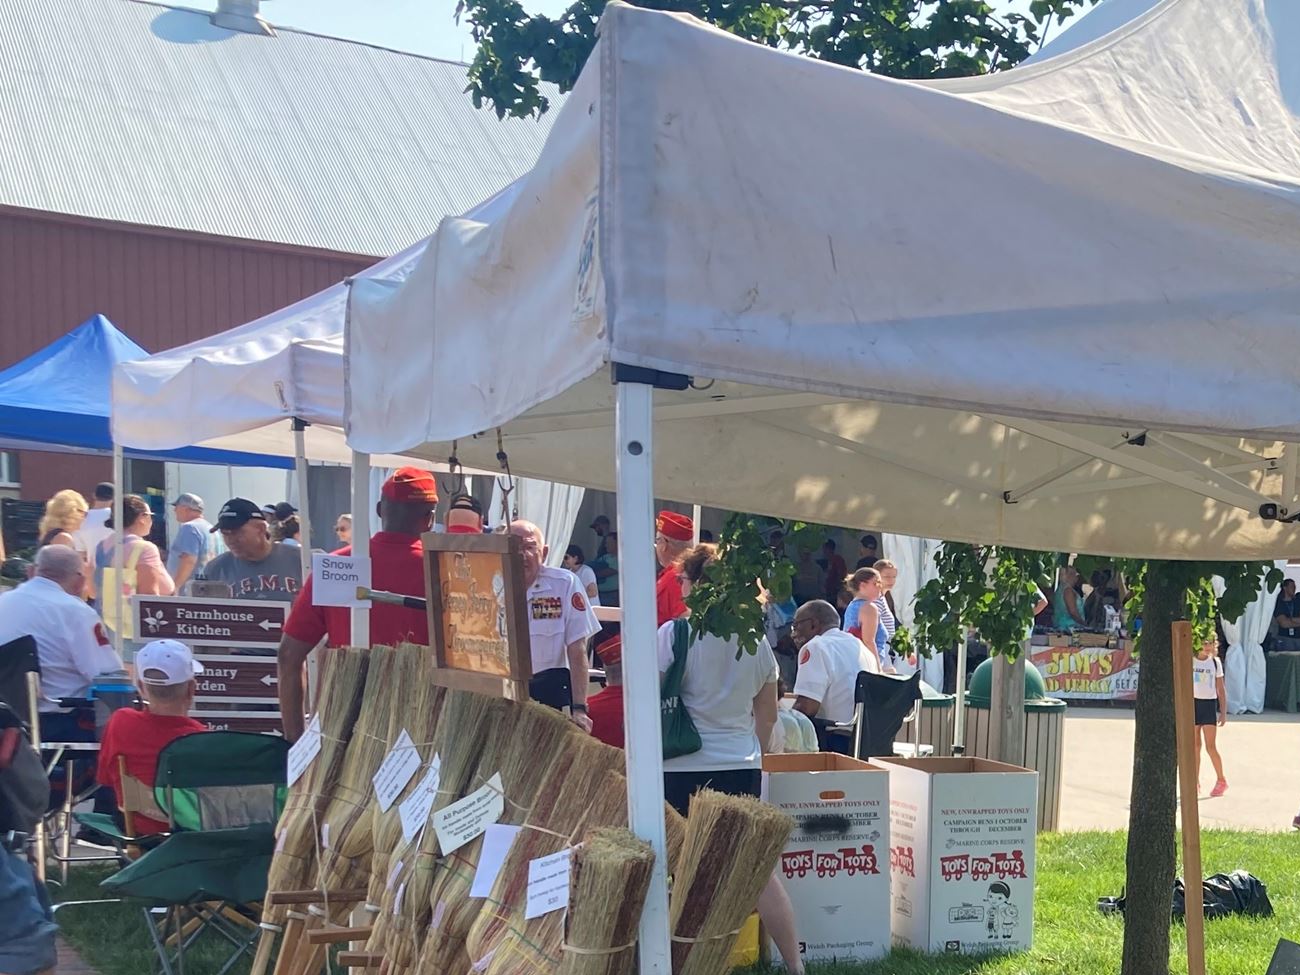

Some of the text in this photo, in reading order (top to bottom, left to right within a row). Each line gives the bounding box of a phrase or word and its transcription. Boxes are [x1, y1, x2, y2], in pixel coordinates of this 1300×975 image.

[322, 558, 354, 570] Snow
[322, 570, 359, 582] Broom
[176, 607, 254, 622] Farmhouse
[176, 623, 231, 636] Kitchen
[1046, 652, 1113, 675] JIM'S
[196, 667, 238, 680] inary
[194, 680, 227, 692] rden
[1044, 678, 1060, 692] AD
[1064, 678, 1112, 693] JERKY
[443, 812, 452, 821] All
[452, 800, 476, 817] Purpose
[800, 801, 842, 809] UNWRAPPED
[845, 811, 878, 819] OCTOBER
[958, 808, 997, 816] UNWRAPPED
[1012, 807, 1030, 815] ONLY
[841, 833, 870, 841] RESERVE
[783, 854, 873, 870] TOYS FOR TOTS
[943, 859, 1021, 873] TOYS FOR TOTS
[856, 940, 874, 948] Group
